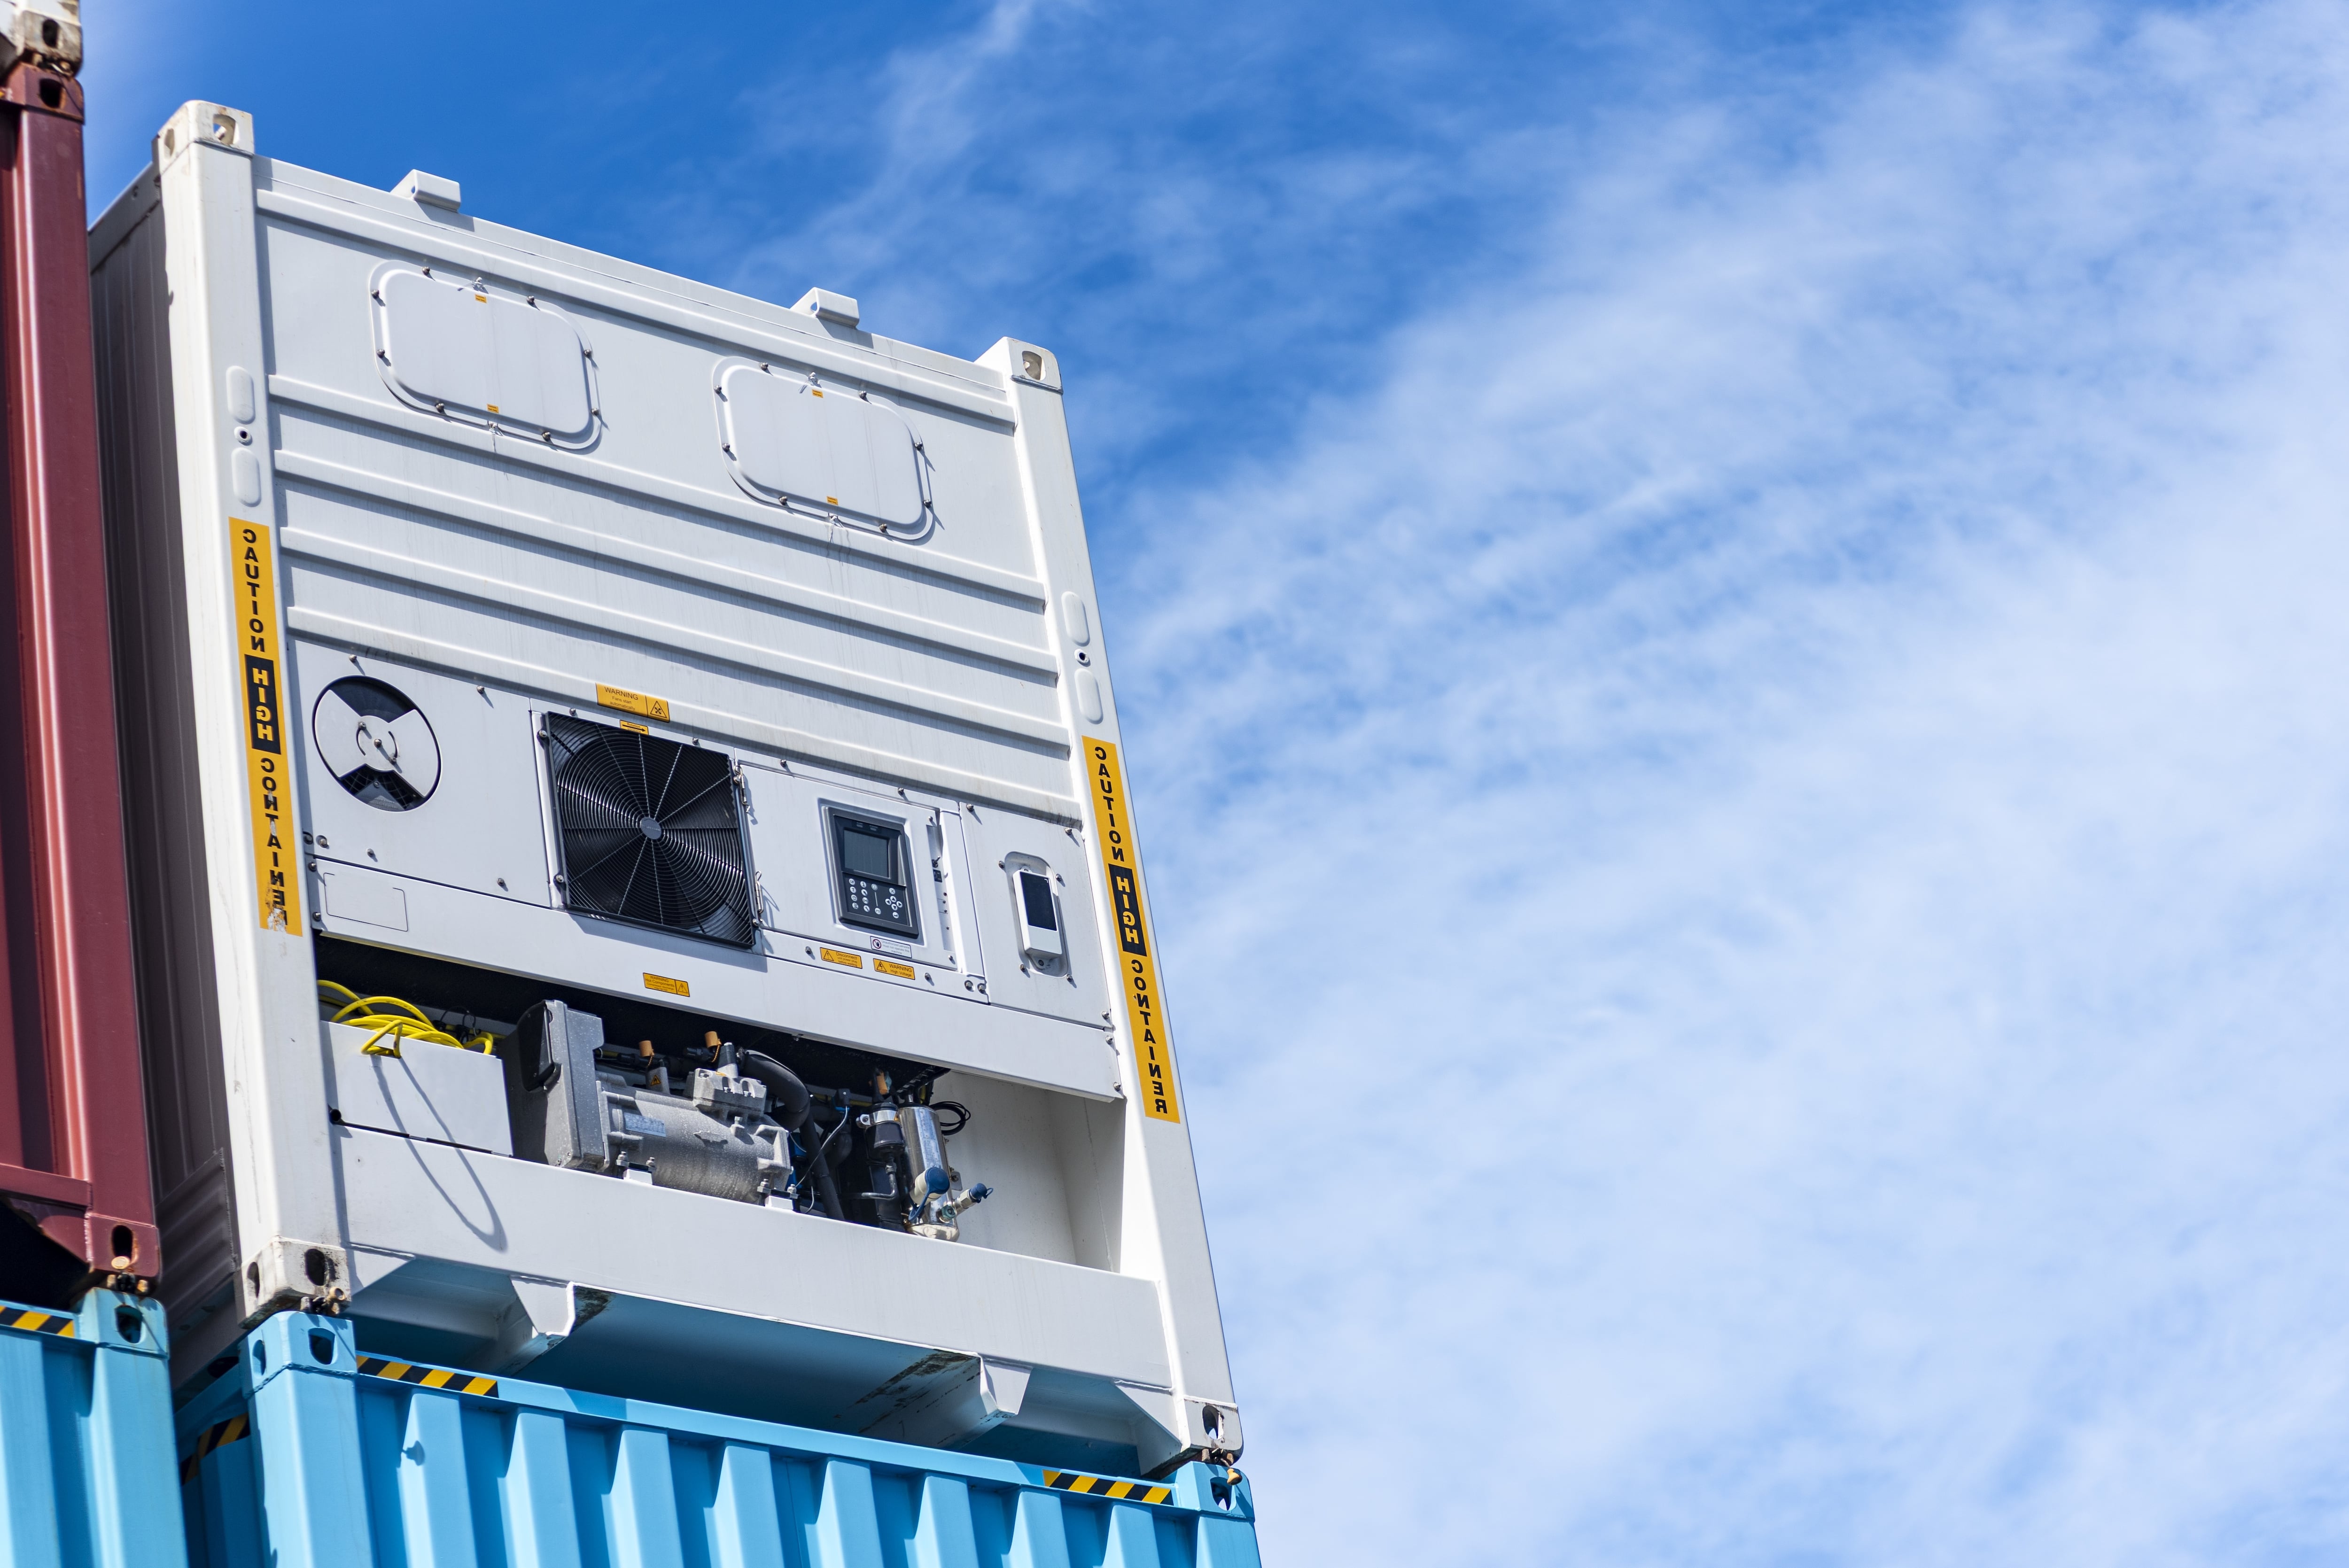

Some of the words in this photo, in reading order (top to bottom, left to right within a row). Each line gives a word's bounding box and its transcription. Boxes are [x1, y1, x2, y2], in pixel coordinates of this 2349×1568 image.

[604, 686, 638, 700] WARNING
[610, 701, 635, 711] automatically
[836, 952, 857, 960] Disconnect
[889, 963, 912, 973] WARNING
